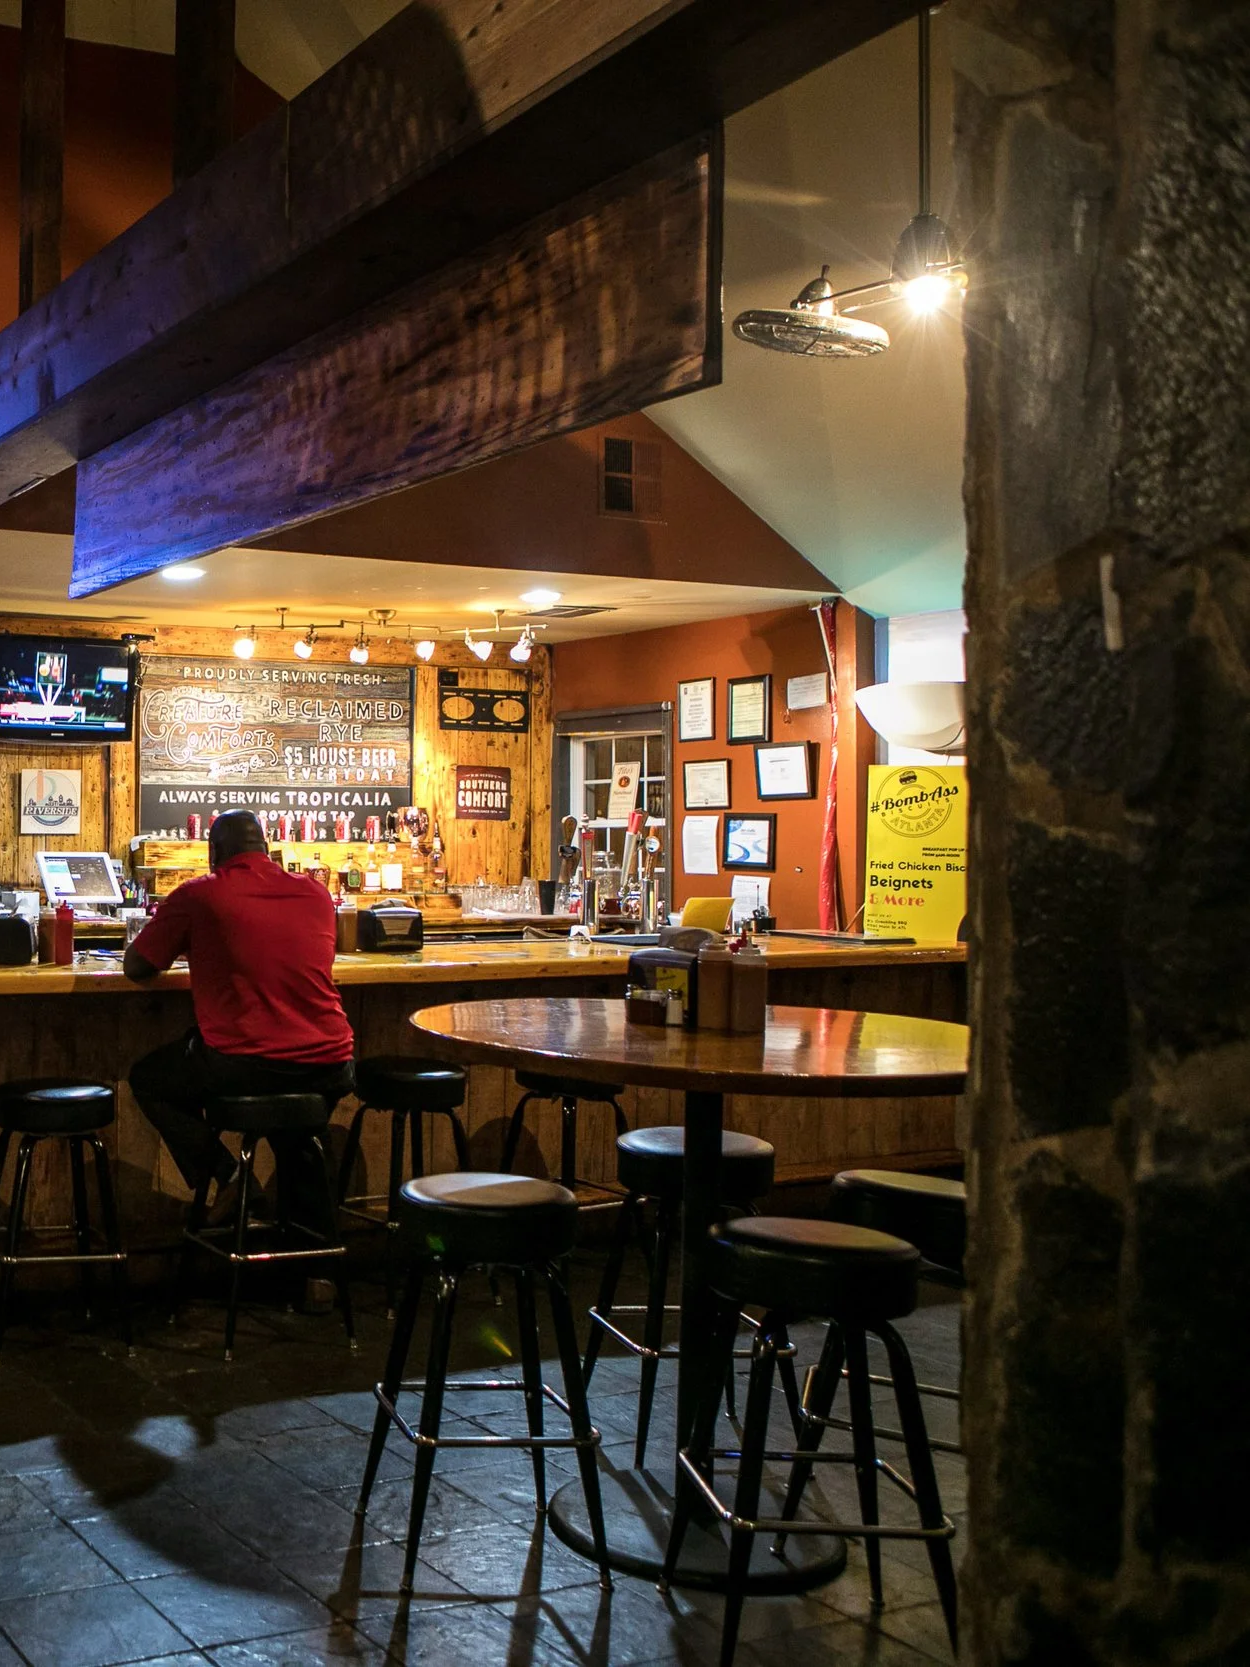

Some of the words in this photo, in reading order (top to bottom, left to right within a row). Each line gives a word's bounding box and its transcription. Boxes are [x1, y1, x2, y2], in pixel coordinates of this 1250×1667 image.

[262, 669, 328, 684] SERVING
[143, 689, 243, 740] CREATURE
[269, 698, 403, 720] RECLAIMED
[319, 723, 363, 742] RYE
[165, 720, 277, 764] COMFORTS
[284, 745, 303, 767] $5
[309, 747, 356, 766] HOUSE
[362, 748, 397, 767] BEER
[288, 766, 394, 782] EVERYDAY
[459, 779, 507, 791] SOUTHERN
[159, 790, 217, 804] ALWAYS
[219, 790, 281, 805] SERVING
[285, 791, 392, 807] TROPICALIA
[458, 790, 508, 809] COMFORT
[870, 786, 959, 813] #BombAss
[881, 797, 950, 818] BISCUITS
[24, 806, 78, 816] RIVERSIDE
[330, 810, 356, 822] TAP
[890, 808, 945, 832] ATLANTA
[870, 860, 894, 870] Fried
[898, 861, 941, 872] Chicken
[870, 875, 934, 891] Beignets
[884, 894, 925, 907] More
